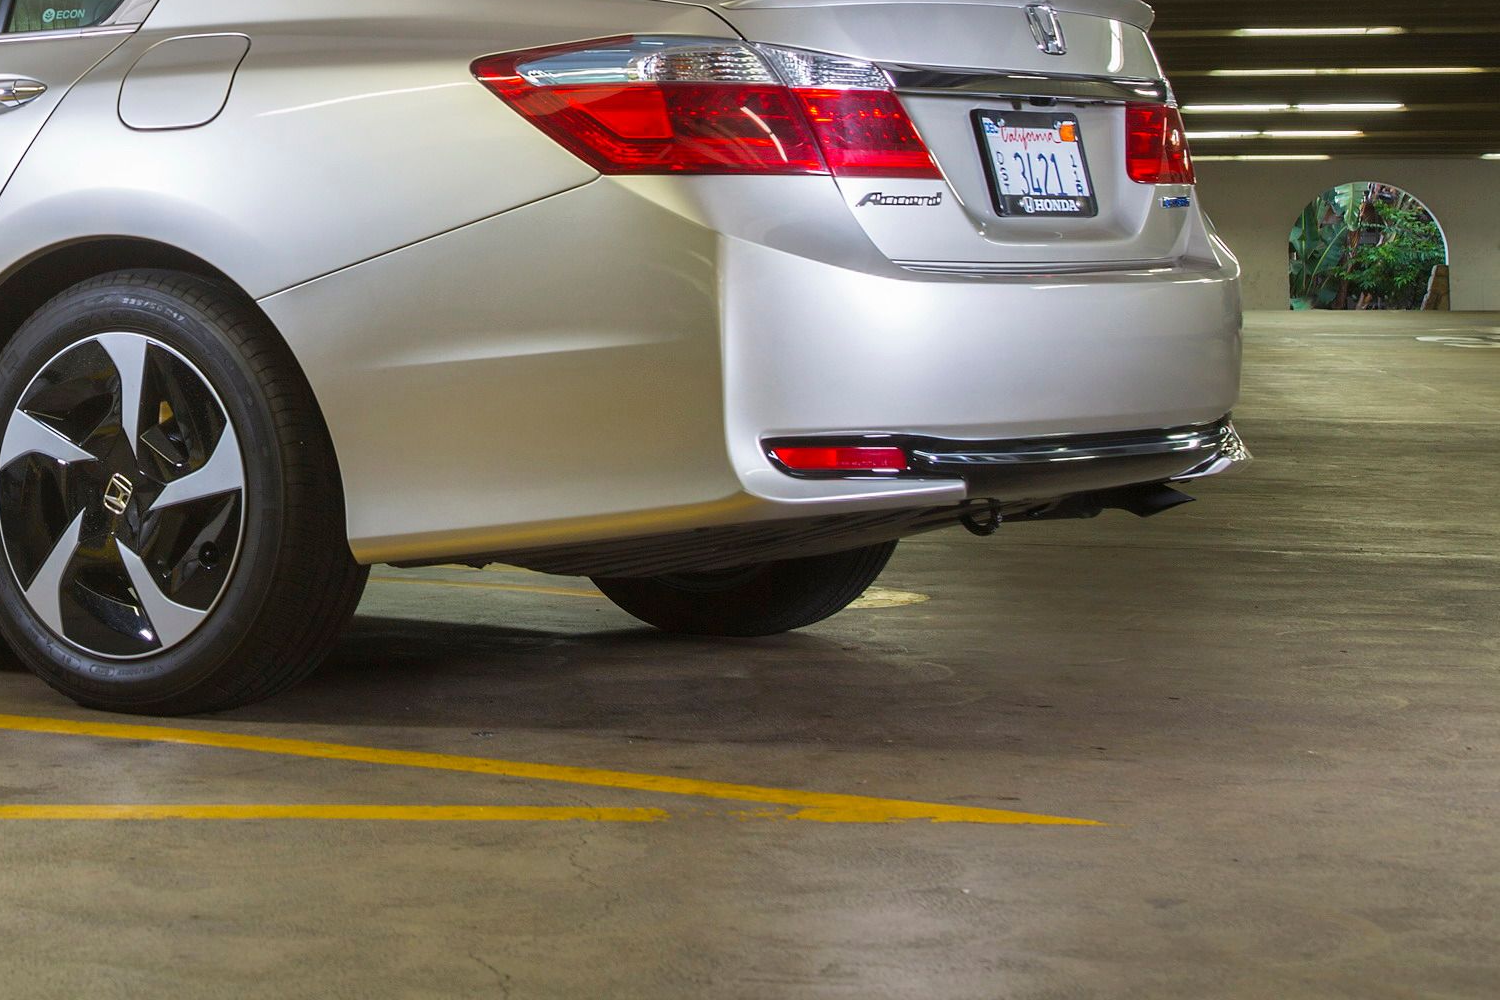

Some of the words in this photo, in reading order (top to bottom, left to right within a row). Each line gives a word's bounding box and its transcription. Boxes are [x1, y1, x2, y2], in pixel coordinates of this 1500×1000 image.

[56, 9, 85, 20] ECON
[1001, 126, 1062, 150] California
[1013, 151, 1067, 196] 3421
[855, 191, 943, 208] Accord
[1033, 199, 1080, 212] HONDA
